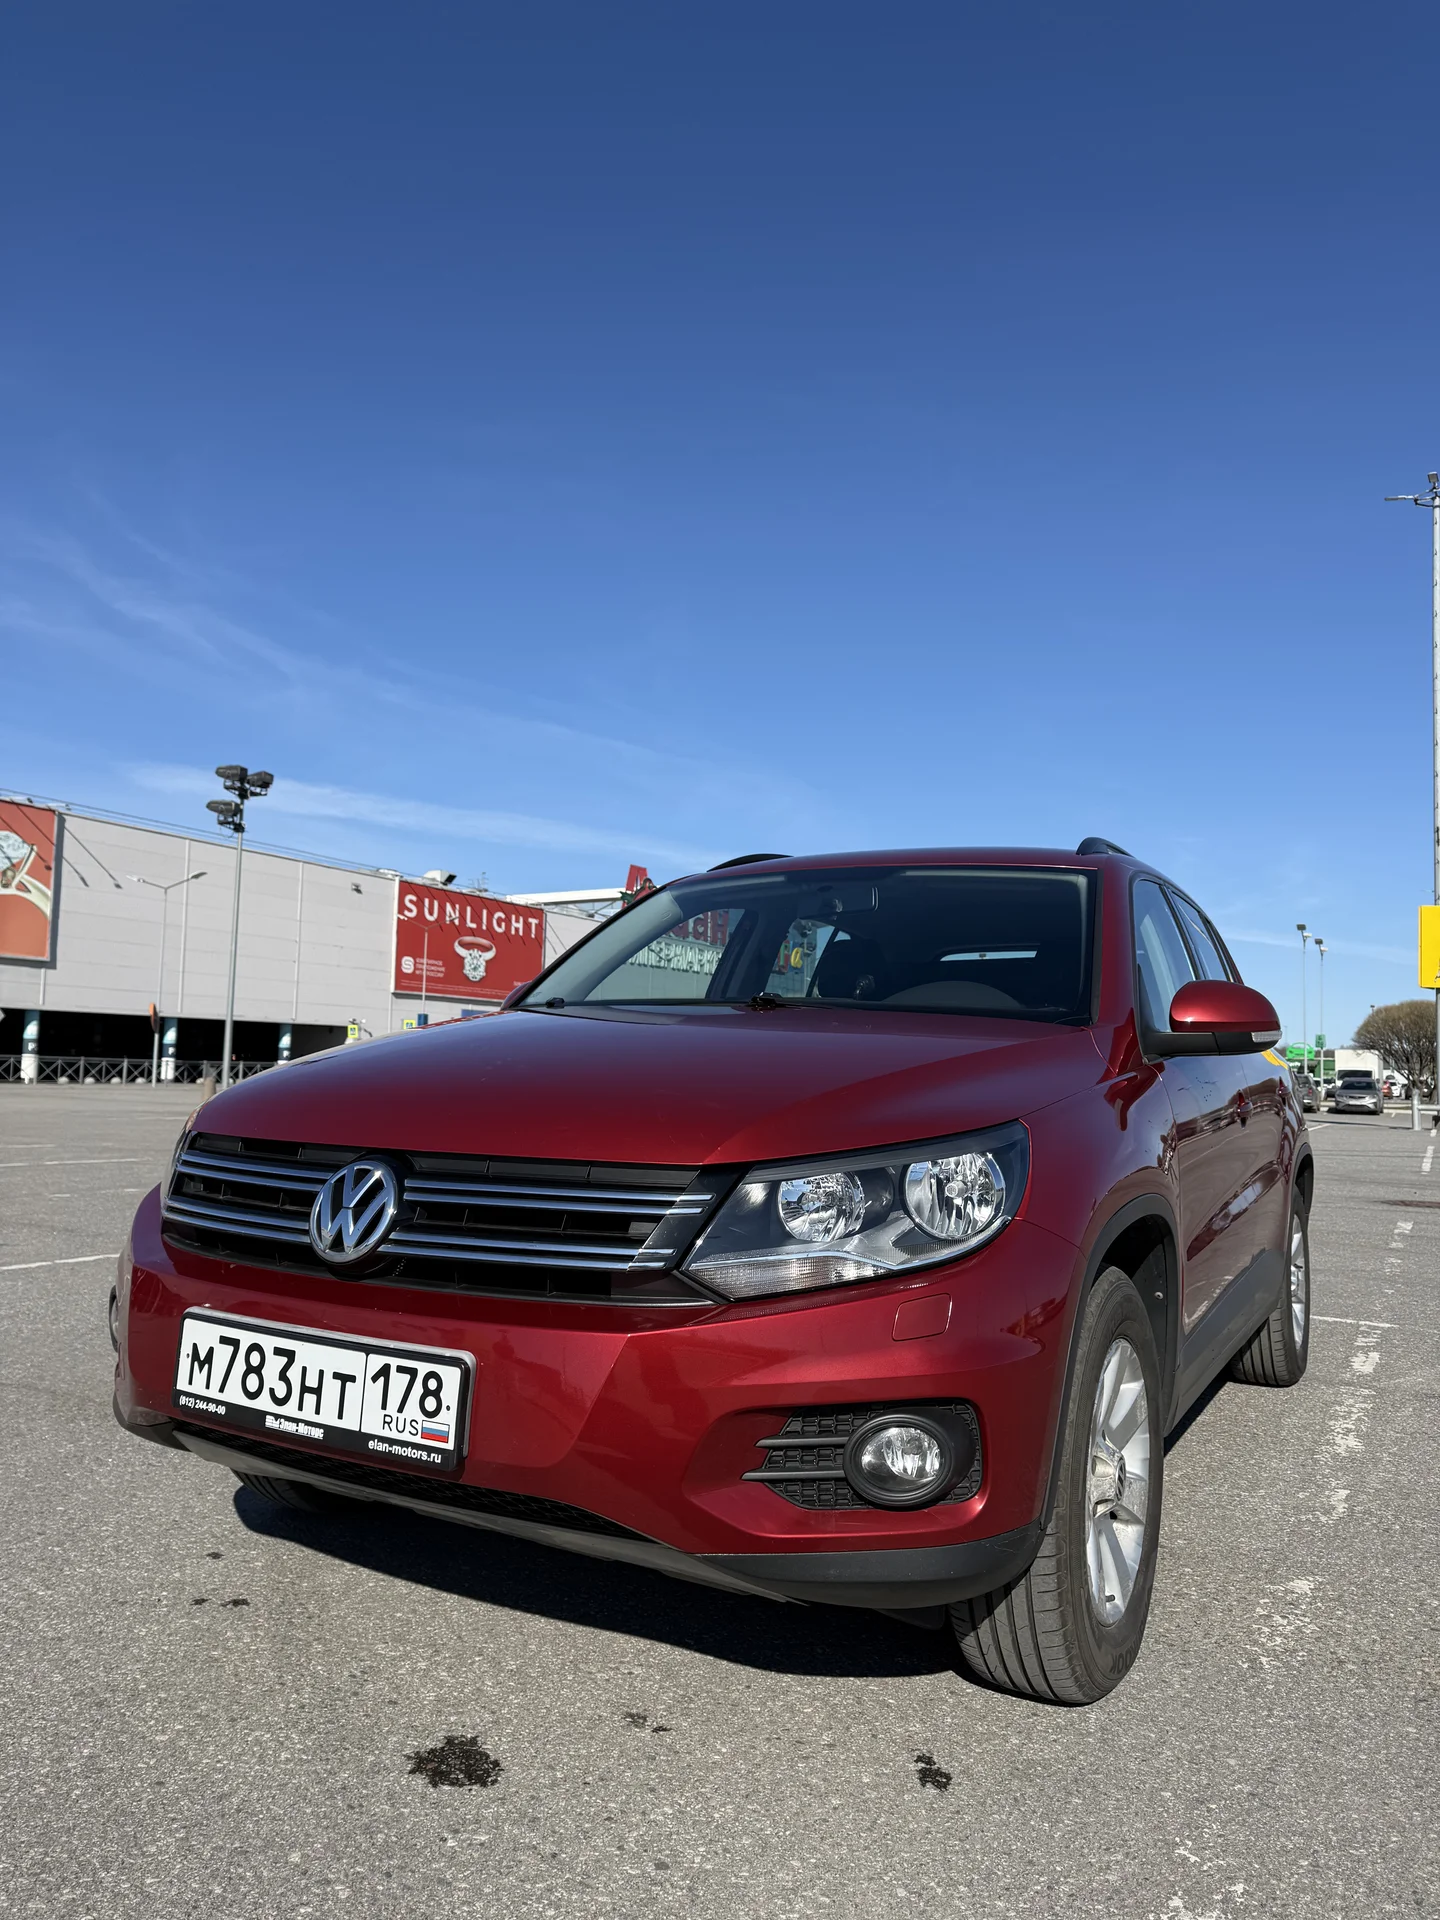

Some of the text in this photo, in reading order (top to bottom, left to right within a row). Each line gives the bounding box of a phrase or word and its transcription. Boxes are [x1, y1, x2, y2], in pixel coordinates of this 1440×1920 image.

[403, 894, 540, 939] SUNLIGHT
[187, 1335, 357, 1420] М783НТ
[370, 1363, 443, 1419] 178
[179, 1395, 226, 1415] (812) 244-90-00
[382, 1414, 419, 1437] RUS
[368, 1438, 442, 1464] elan-motors.ru
